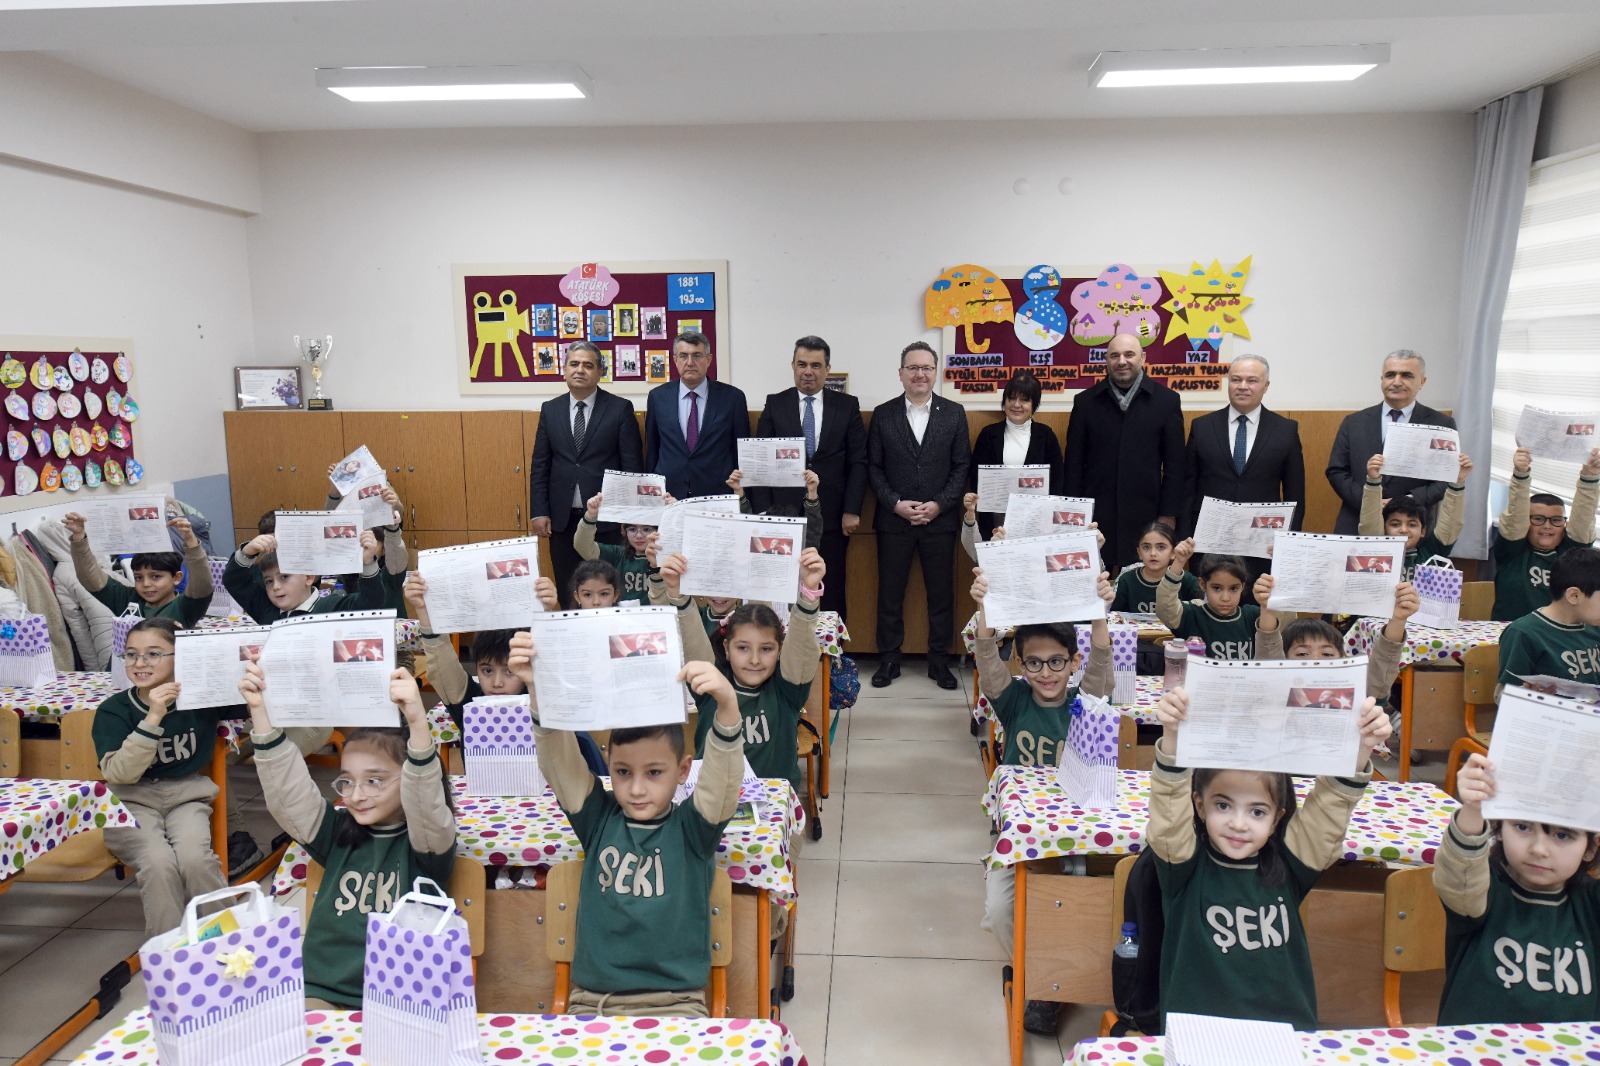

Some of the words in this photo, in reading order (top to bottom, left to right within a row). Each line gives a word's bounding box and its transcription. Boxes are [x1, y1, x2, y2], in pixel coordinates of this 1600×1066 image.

[567, 279, 609, 292] ATATÜRK
[678, 277, 698, 287] 1881
[949, 356, 1002, 366] SONBAHAR
[1030, 353, 1051, 365] KIŞ
[1188, 353, 1208, 362] YAZ
[945, 368, 976, 380] EYLÜL
[981, 367, 1008, 379] EKİM
[1051, 368, 1078, 378] OCAK
[1151, 365, 1195, 375] HAZİRAN
[962, 383, 994, 392] KASIM
[152, 727, 196, 767] EKİ
[598, 845, 664, 898] ŞEKİ
[1206, 896, 1290, 954] ŞEKİ
[1493, 936, 1592, 996] ŞEKİ
